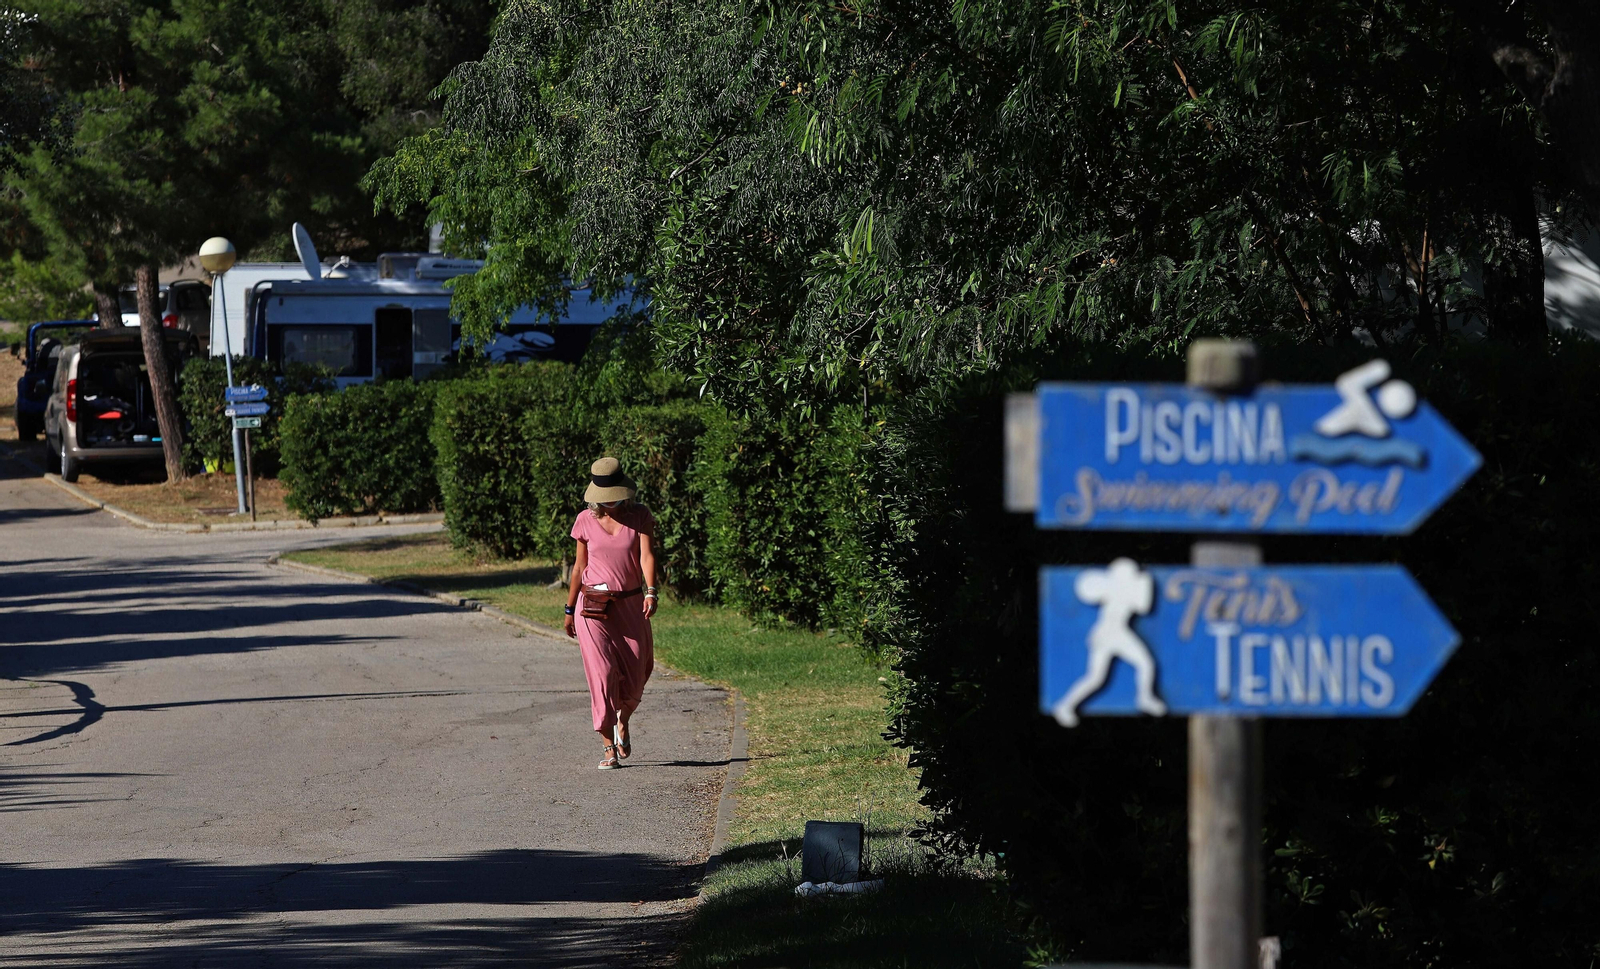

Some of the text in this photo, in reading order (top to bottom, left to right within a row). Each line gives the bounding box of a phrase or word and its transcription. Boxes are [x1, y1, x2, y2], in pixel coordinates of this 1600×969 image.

[1106, 389, 1286, 464] PISCINA
[1060, 468, 1282, 528] Swimming
[1166, 571, 1303, 639] Tenis
[1209, 624, 1394, 708] TENNIS
